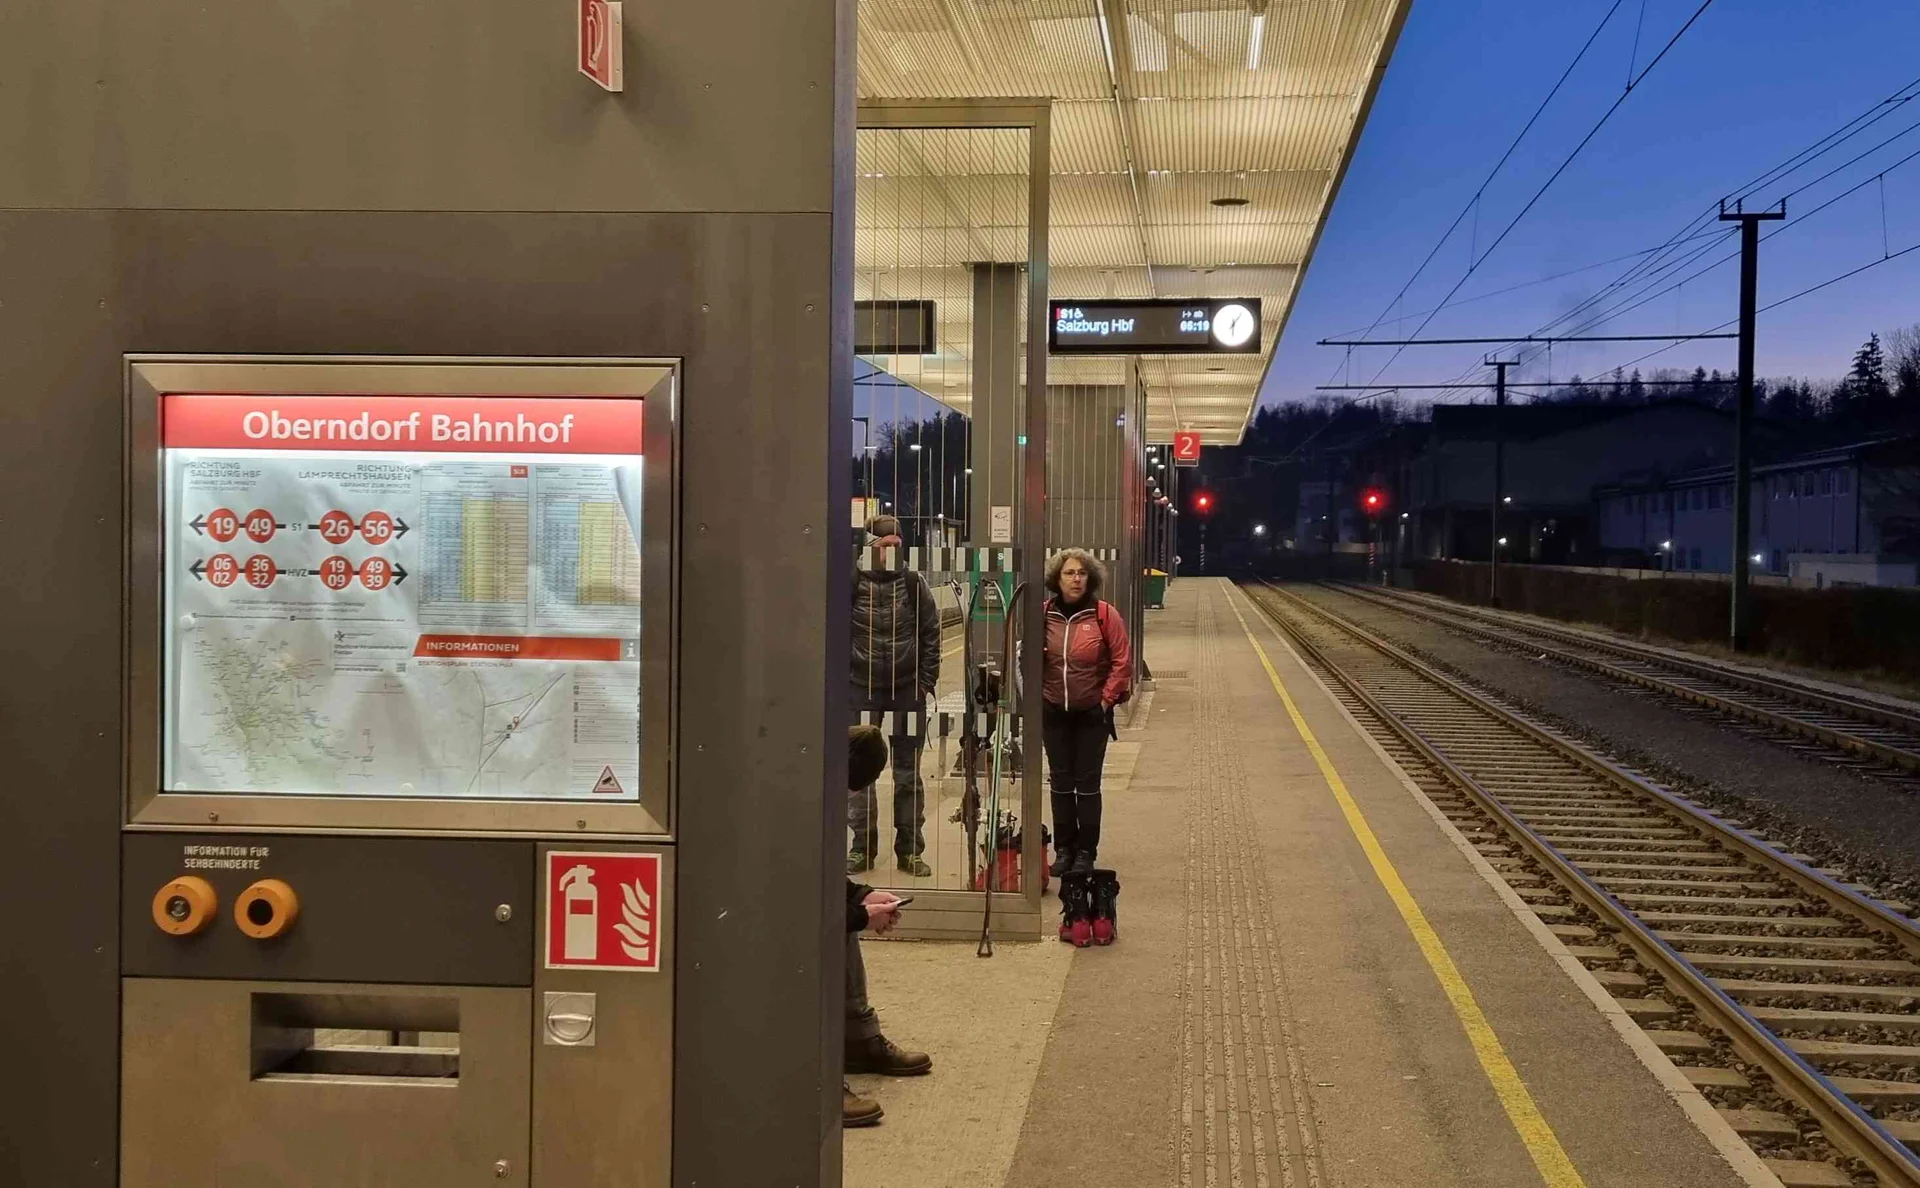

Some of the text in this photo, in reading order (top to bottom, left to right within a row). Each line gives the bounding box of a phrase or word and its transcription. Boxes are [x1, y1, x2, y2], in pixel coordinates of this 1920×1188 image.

[1060, 308, 1074, 319] S1
[1056, 319, 1135, 335] Salzburg Hbf
[242, 410, 574, 443] Oberndorf Bahnhof
[1180, 436, 1193, 455] 2
[190, 461, 241, 469] RICHTUNG
[357, 464, 411, 473] RICHTUNG
[190, 469, 262, 478] SALZBURG HBF
[298, 471, 411, 481] LAMPRECHTSHAUSEN
[213, 517, 234, 535] 19
[249, 517, 271, 536] 49
[291, 523, 302, 531] S1
[325, 519, 348, 538] 26
[365, 519, 388, 538] 56
[213, 557, 231, 571] 06
[252, 558, 269, 571] 36
[330, 560, 345, 573] 19
[366, 560, 384, 574] 49
[213, 572, 230, 585] 02
[287, 568, 307, 577] HVZ
[252, 573, 268, 586] 32
[327, 574, 346, 587] 09
[366, 574, 384, 587] 39
[426, 642, 519, 652] INFORMATIONEN
[184, 845, 247, 856] INFORMATION
[184, 858, 260, 869] SEHBEHINDERTE
